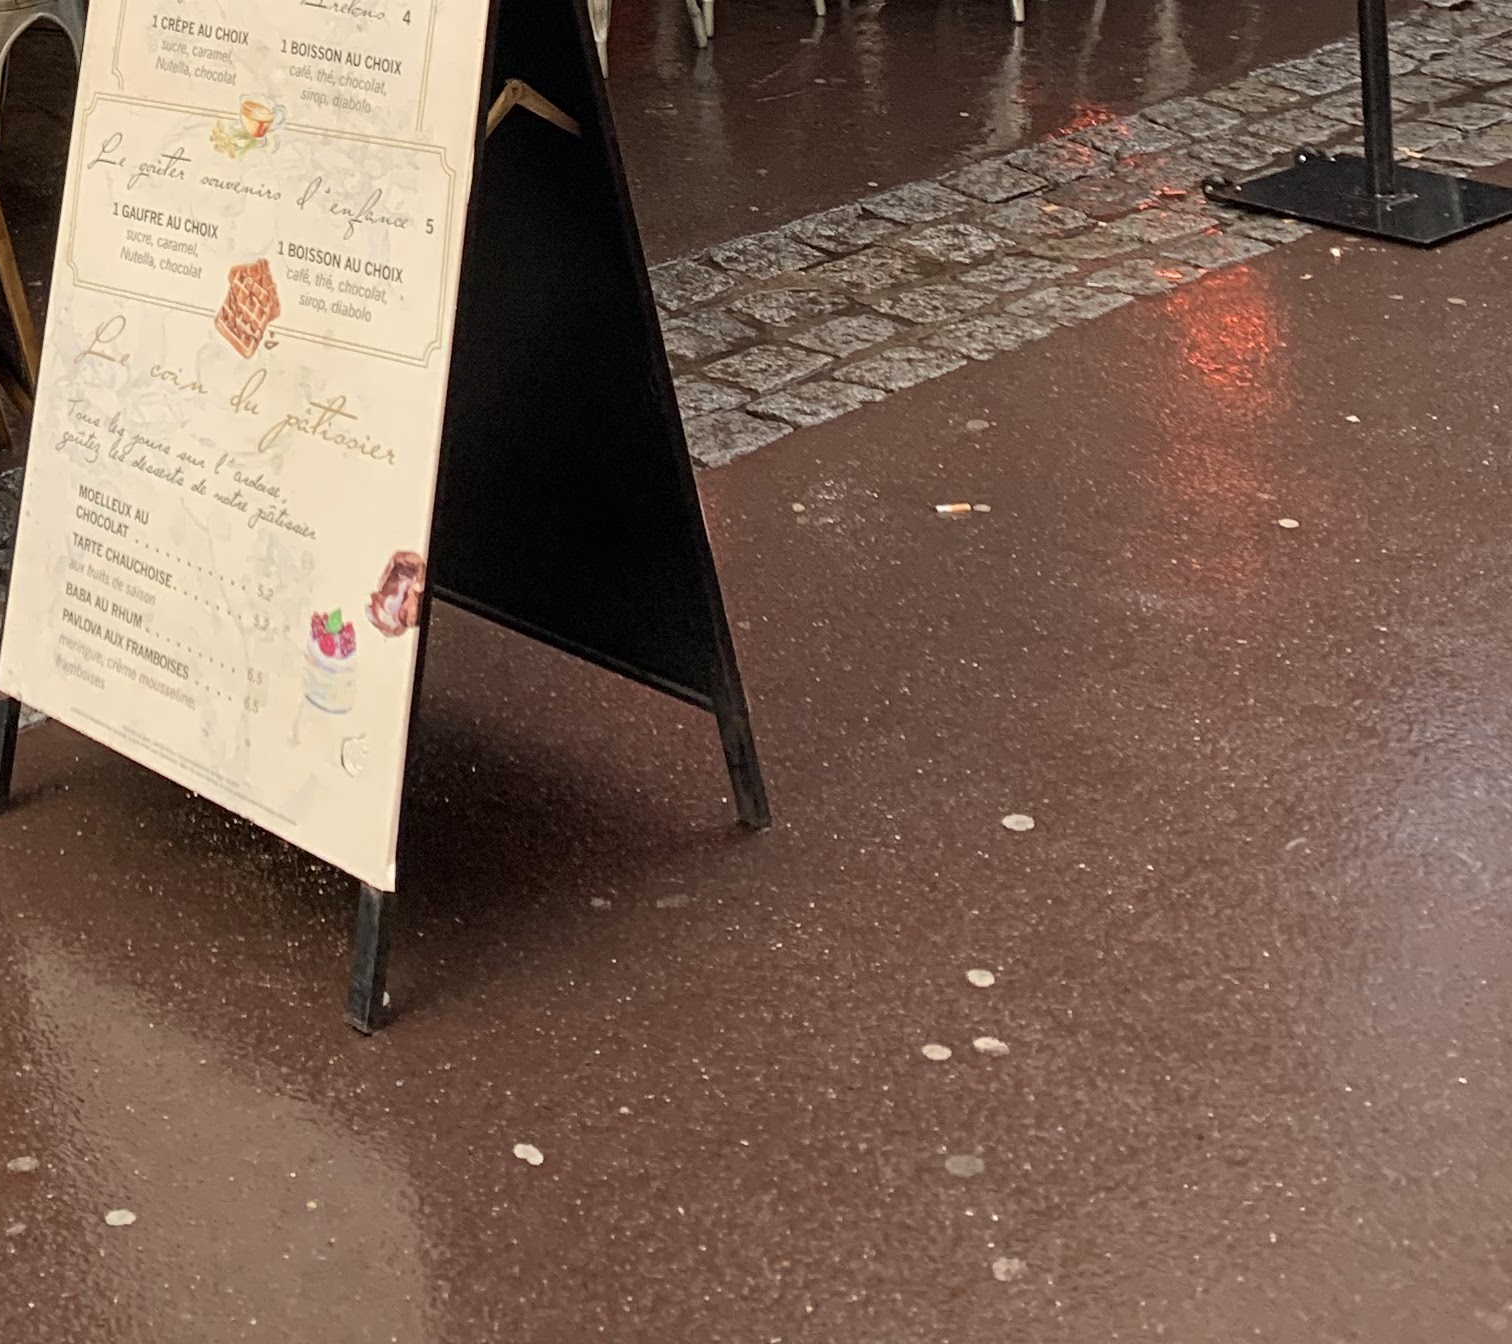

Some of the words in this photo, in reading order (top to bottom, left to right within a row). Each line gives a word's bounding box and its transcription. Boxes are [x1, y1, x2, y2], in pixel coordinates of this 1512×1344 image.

[152, 15, 158, 29] 1
[161, 16, 195, 35] CRÊPE
[197, 24, 212, 39] AU
[215, 27, 249, 45] CHOIX
[402, 10, 412, 25] 4
[155, 56, 192, 76] Nutella,
[194, 64, 237, 86] chocolat
[192, 45, 233, 65] caramel,
[280, 39, 288, 53] 1
[290, 41, 342, 63] BOISSON
[345, 52, 362, 67] AU
[366, 55, 403, 75] CHOIX
[289, 63, 313, 81] café,
[317, 68, 336, 85] thé,
[339, 73, 387, 96] chocolat,
[332, 94, 372, 114] diabolo
[88, 132, 127, 170] Le
[199, 176, 282, 201] souvenirs
[425, 218, 434, 235] 5
[112, 202, 119, 216] 1
[122, 204, 164, 227] GAUFRE
[166, 214, 182, 231] AU
[184, 218, 219, 239] CHOIX
[126, 228, 154, 248] sucre,
[157, 236, 199, 258] caramel,
[120, 246, 157, 269] Nutella,
[160, 256, 203, 280] chocolat
[277, 240, 284, 256] 1
[288, 243, 343, 269] BOISSON
[345, 257, 362, 274] AU
[364, 261, 404, 284] CHOIX
[287, 267, 312, 287] café,
[314, 273, 335, 293] thé,
[331, 300, 372, 323] diabolo
[74, 314, 130, 367] Le
[150, 363, 208, 395] coin
[230, 368, 267, 416] du
[258, 395, 396, 465] pâtissier
[68, 398, 101, 428] Tous
[108, 412, 125, 437] les
[123, 427, 171, 456] jours
[176, 452, 205, 469] sur
[108, 438, 125, 463] les
[132, 454, 185, 488] desserts
[191, 479, 207, 496] de
[213, 490, 249, 513] notre
[76, 505, 129, 538] CHOCOLAT
[79, 484, 133, 518] MOELLEUX
[135, 510, 150, 525] AU
[72, 532, 103, 558] TARTE
[68, 559, 86, 573] aux
[87, 562, 110, 585] fruits
[111, 576, 124, 592] de
[126, 583, 156, 607] saison
[65, 582, 92, 605] BABA
[95, 598, 109, 613] AU
[112, 603, 143, 629] RHUM
[62, 608, 102, 638] PAVLOVA
[104, 630, 123, 647] AUX
[126, 638, 189, 680] FRAMBOISES
[56, 653, 105, 690] framboises
[107, 656, 137, 681] crème
